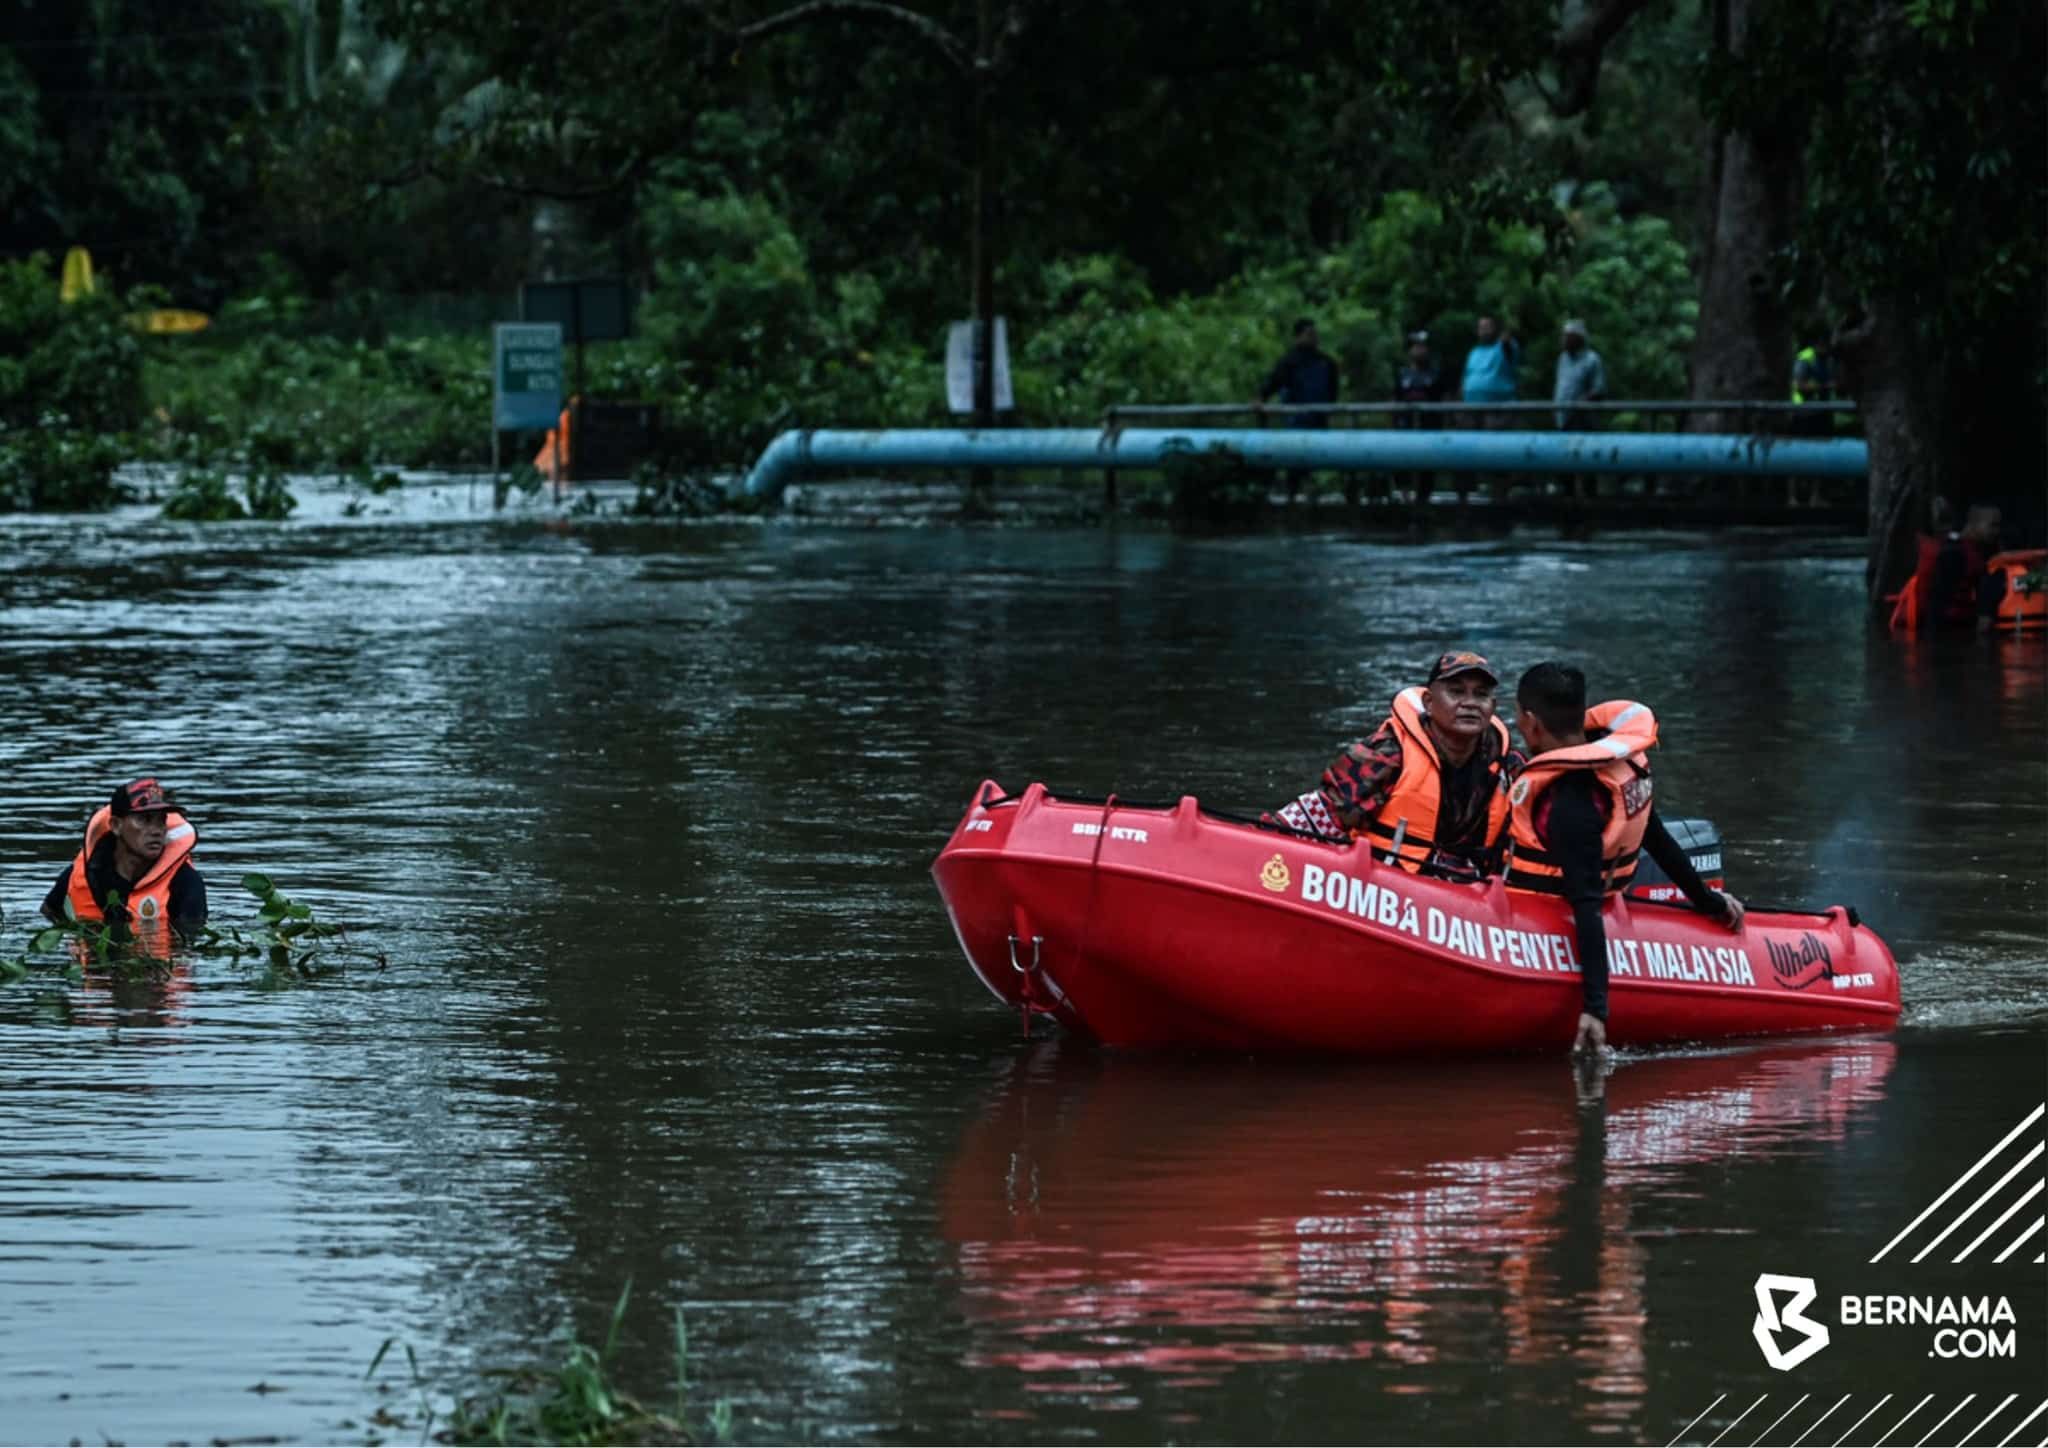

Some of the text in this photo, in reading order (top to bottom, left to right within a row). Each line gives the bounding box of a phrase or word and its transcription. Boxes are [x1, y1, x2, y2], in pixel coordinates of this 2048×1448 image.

[1111, 826, 1149, 843] KTR
[1301, 863, 1756, 987] BOMBA DAN PENYELAT MALAYSIA
